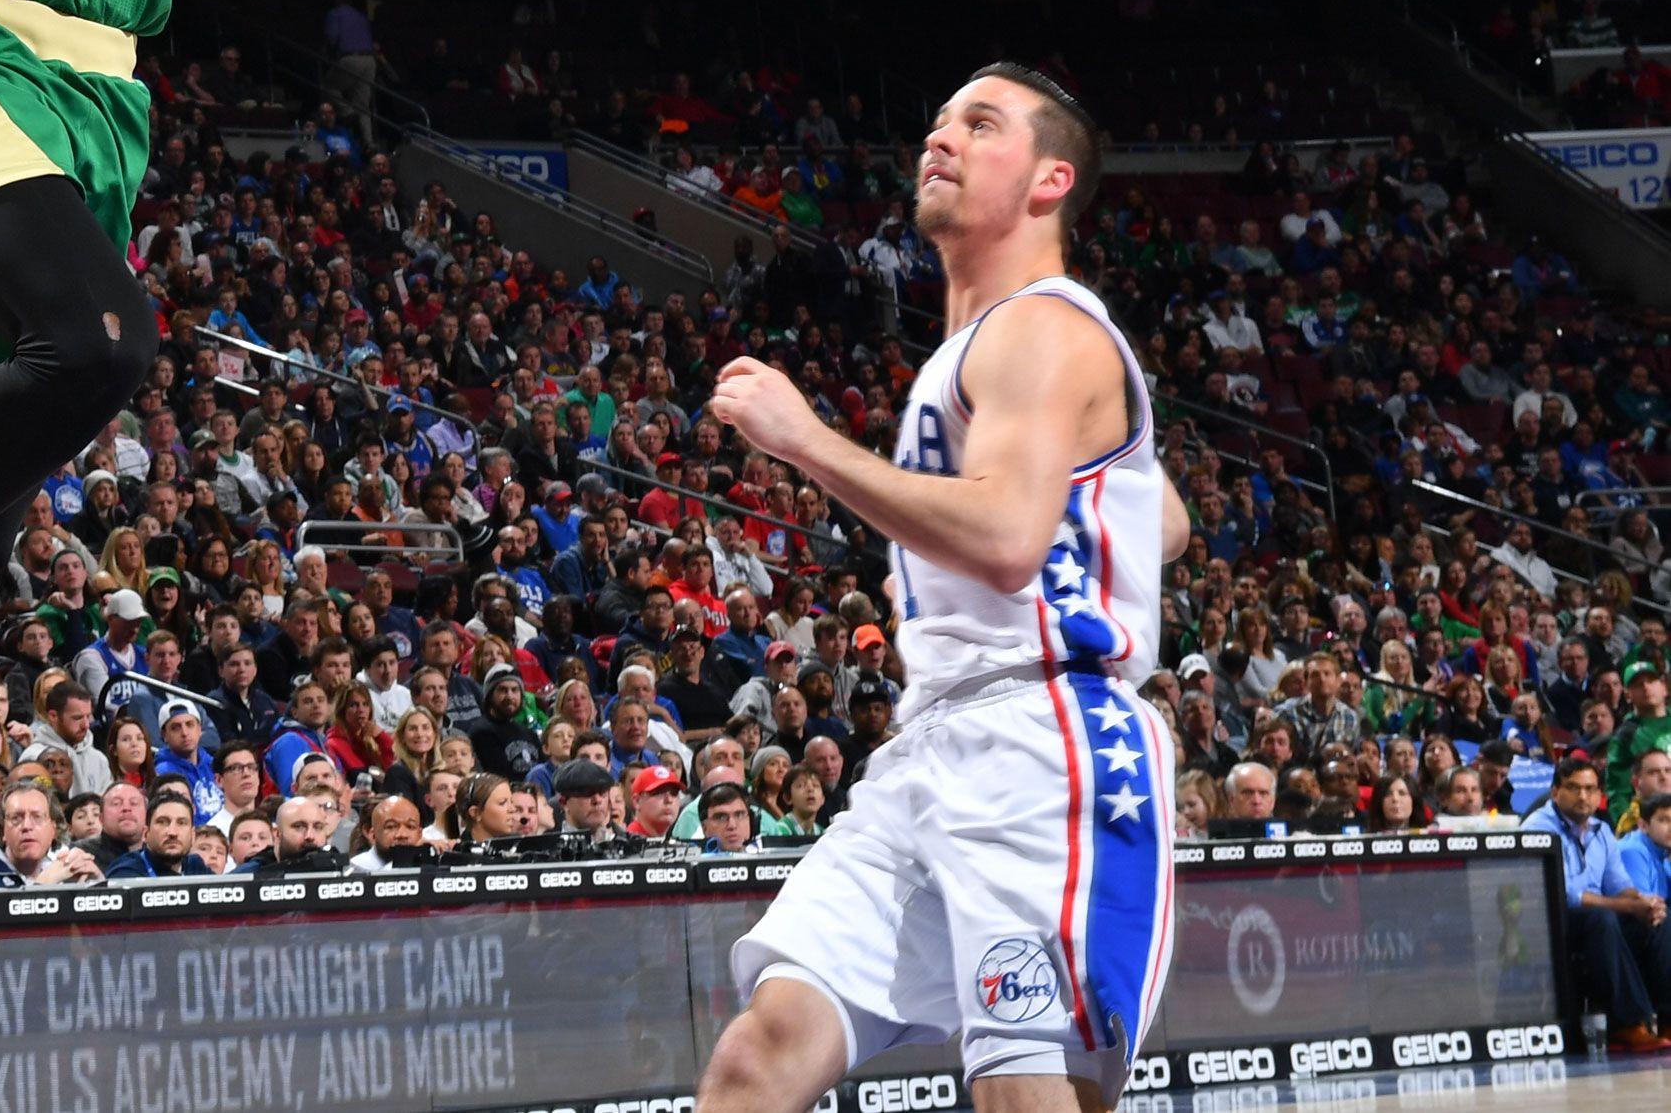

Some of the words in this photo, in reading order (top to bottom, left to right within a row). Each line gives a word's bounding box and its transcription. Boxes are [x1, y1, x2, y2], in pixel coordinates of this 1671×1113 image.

[1212, 846, 1245, 861] GEICO
[1254, 844, 1286, 859] GEICO
[1294, 843, 1326, 857] GEICO
[1332, 841, 1364, 856] GEICO
[1372, 840, 1403, 854] GEICO
[1409, 838, 1440, 853] GEICO
[1447, 836, 1478, 851] GEICO
[1485, 835, 1516, 849] GEICO
[1521, 834, 1552, 848] GEICO
[9, 897, 59, 915] GEICO
[73, 894, 123, 912] GEICO
[142, 889, 190, 908] GEICO
[198, 886, 245, 905] GEICO
[260, 884, 306, 902] GEICO
[318, 881, 364, 900] GEICO
[375, 879, 419, 897] GEICO
[433, 876, 477, 894] GEICO
[486, 873, 528, 891] GEICO
[540, 871, 581, 888] GEICO
[592, 869, 634, 885] GEICO
[646, 867, 687, 883] GEICO
[708, 866, 748, 882] GEICO
[1294, 931, 1415, 966] ROTHMAN
[46, 952, 164, 1032] CAMP,
[177, 940, 391, 1025] OVERNIGHT
[402, 934, 511, 1011] CAMP,
[982, 972, 1052, 1007] 76ers
[114, 1032, 304, 1113] ACADEMY,
[317, 1024, 392, 1102] AND
[403, 1018, 516, 1096] MORE!
[857, 1075, 957, 1113] GEICO
[1188, 1047, 1275, 1084] GEICO
[1290, 1037, 1373, 1074] GEICO
[1393, 1030, 1472, 1068] GEICO
[1485, 1024, 1565, 1060] GEICO
